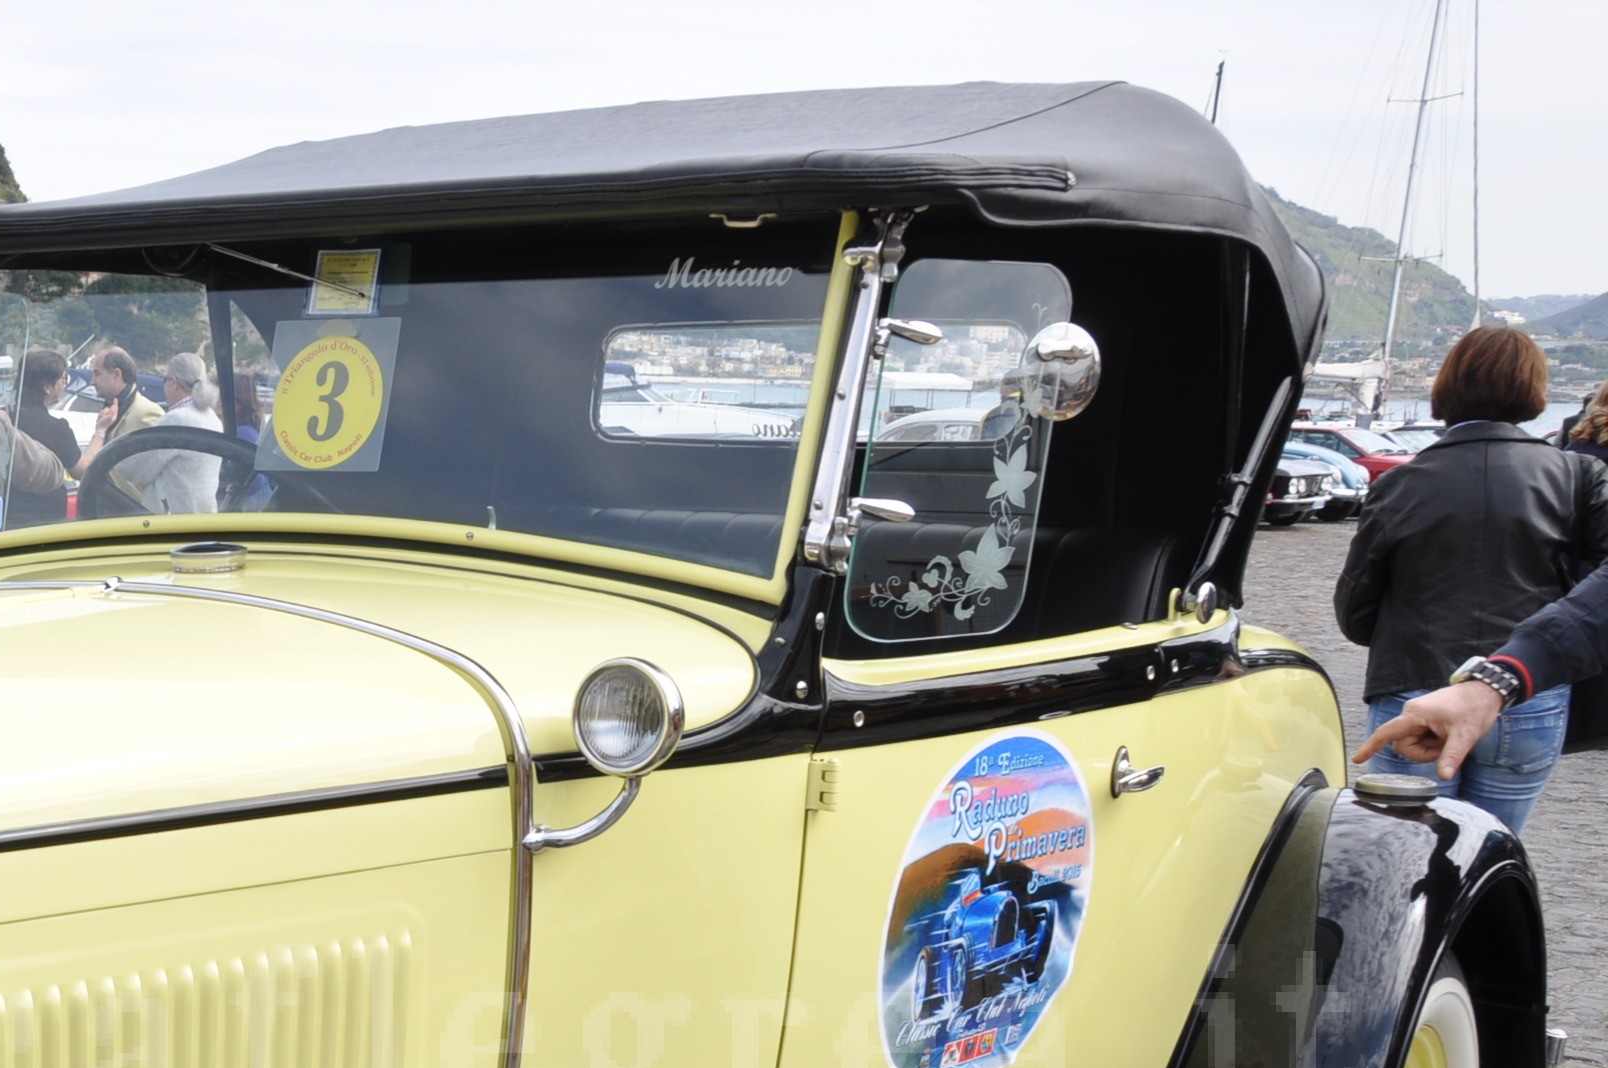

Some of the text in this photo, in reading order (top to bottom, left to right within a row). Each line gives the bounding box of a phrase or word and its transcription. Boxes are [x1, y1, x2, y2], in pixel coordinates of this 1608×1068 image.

[654, 256, 794, 290] Mariano
[283, 343, 328, 385] Triangolo
[330, 340, 358, 355] d'Oro
[306, 360, 350, 442] 3
[280, 430, 363, 463] Classic Car Club Napoli
[997, 752, 1045, 776] Edizione
[949, 780, 1030, 841] Raduno
[984, 820, 1087, 876] Primavera
[896, 1020, 941, 1047] Classic
[946, 1005, 973, 1032] Car
[976, 995, 1008, 1022] Club
[1007, 984, 1051, 1017] Napoli
